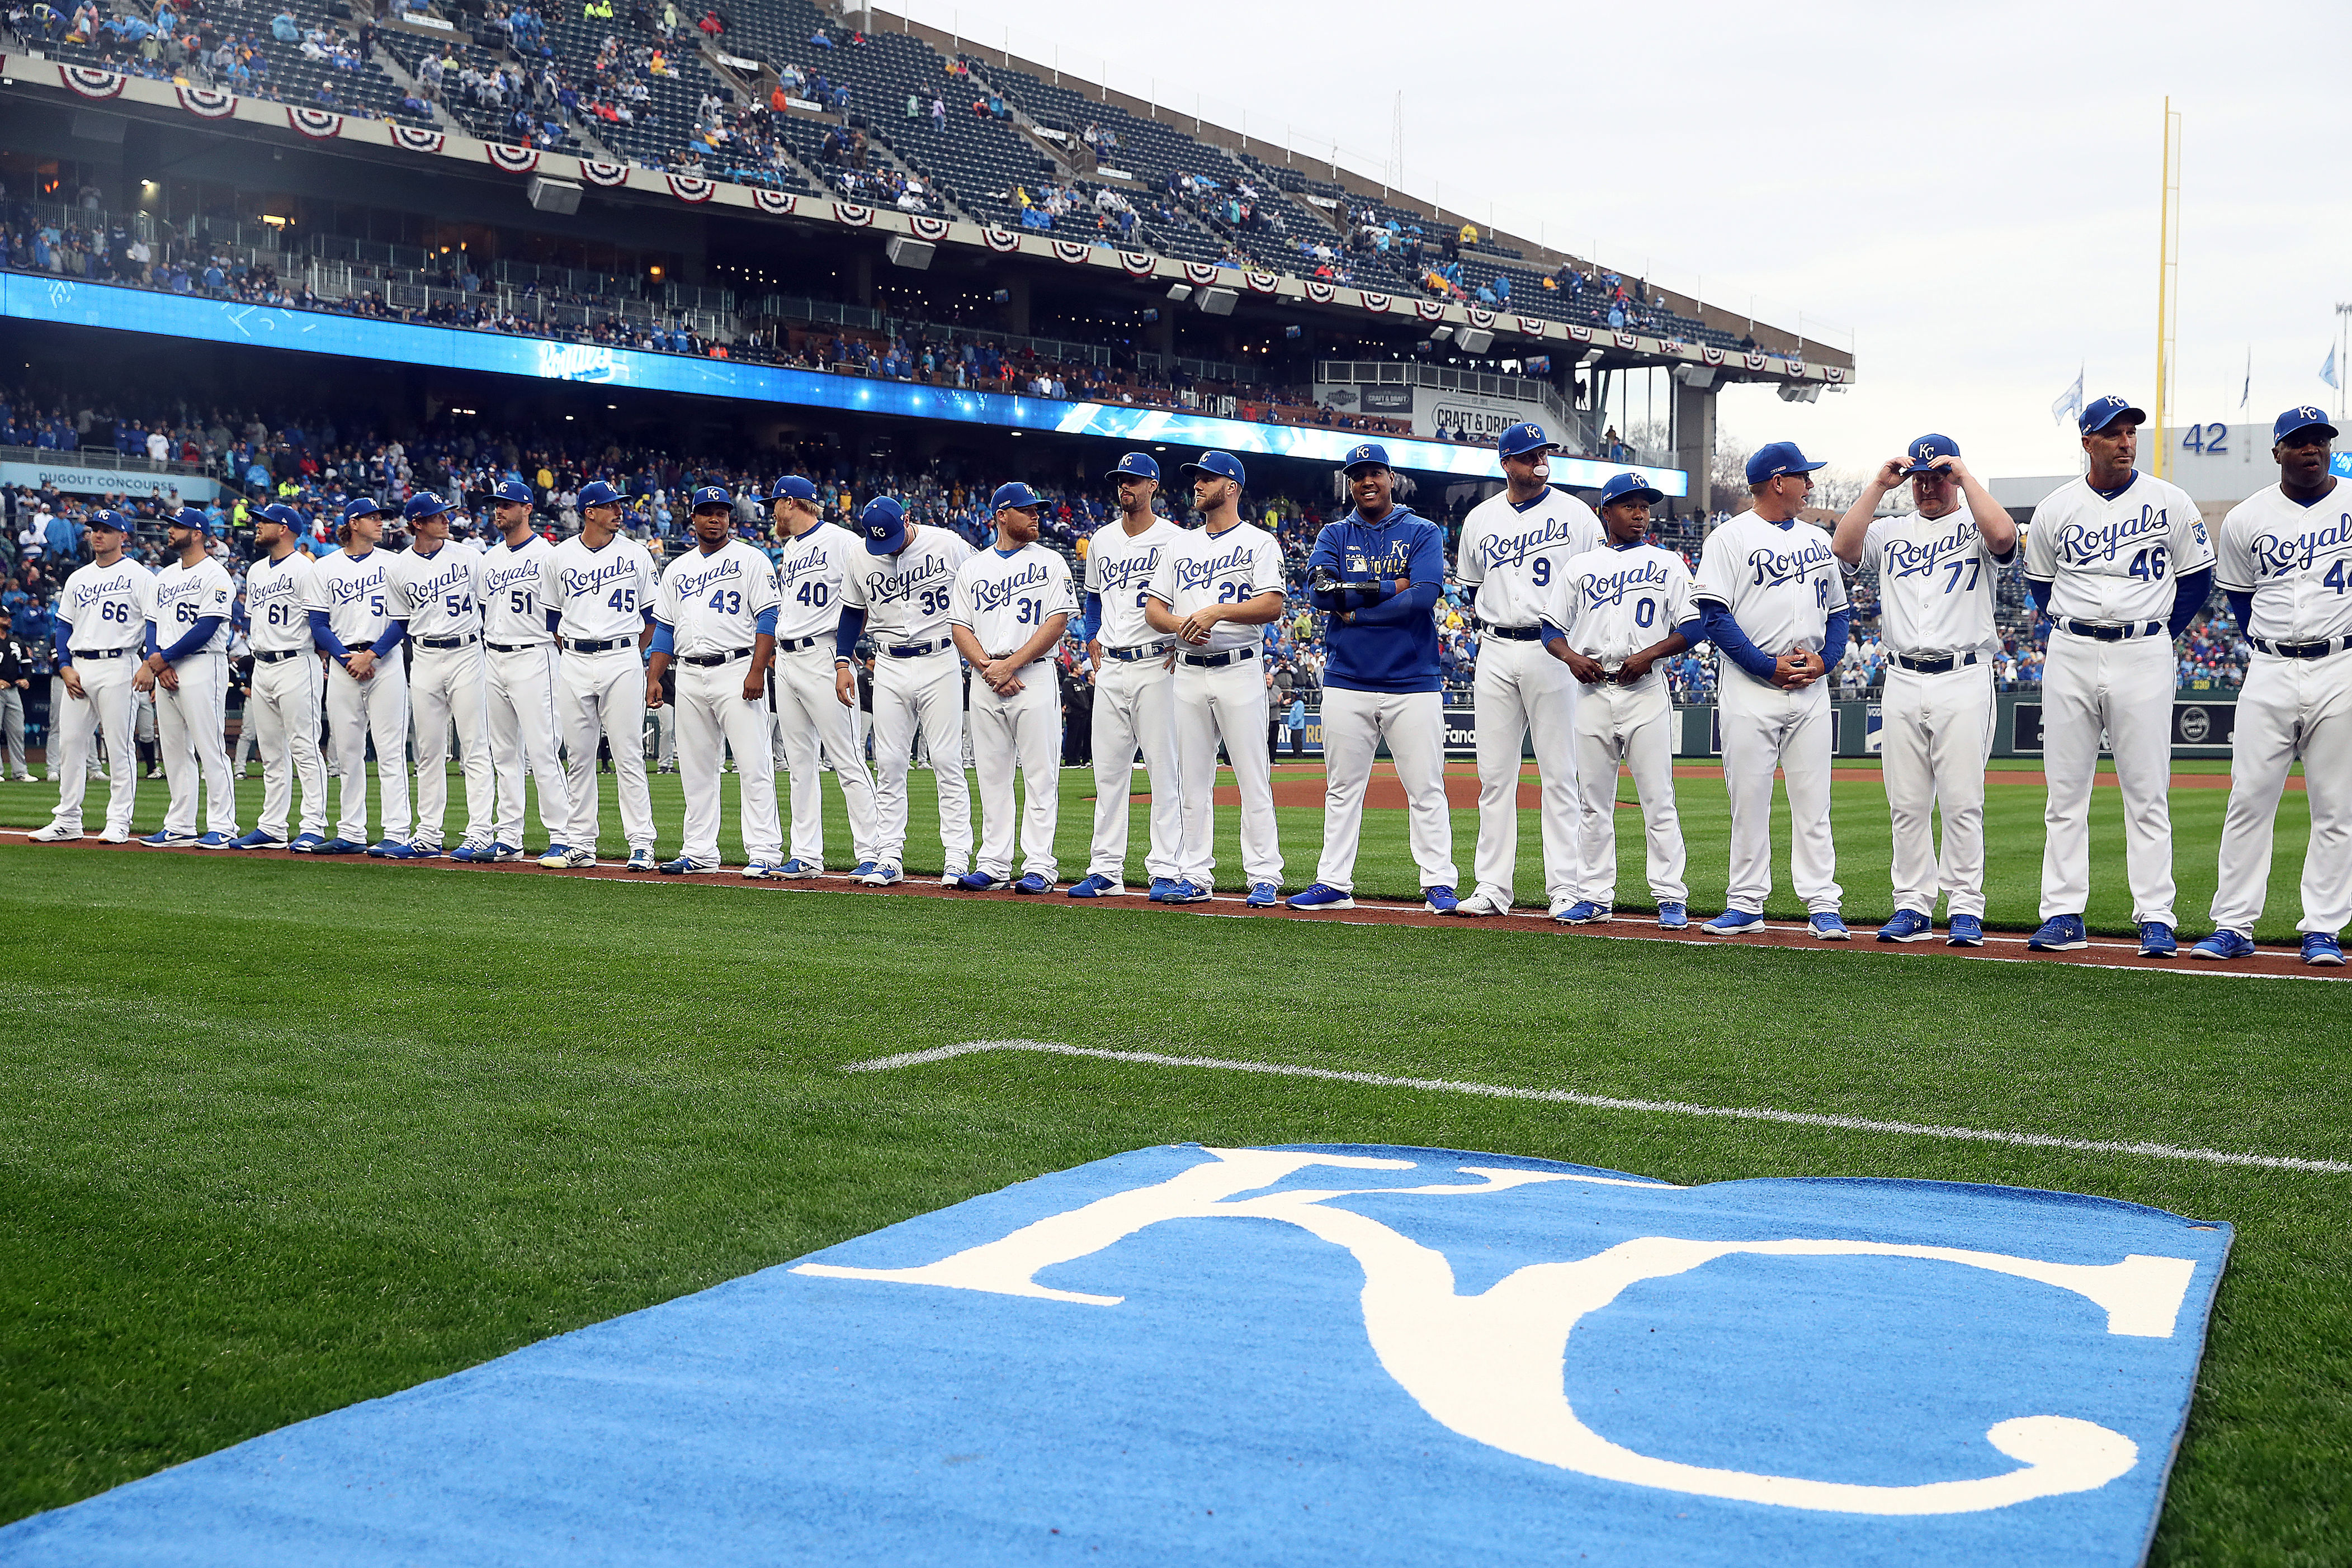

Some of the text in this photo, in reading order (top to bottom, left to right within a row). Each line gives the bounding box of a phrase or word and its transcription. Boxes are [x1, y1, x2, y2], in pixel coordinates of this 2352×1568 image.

[2104, 395, 2125, 407] KC
[2298, 405, 2317, 420] KC
[1438, 409, 1520, 433] CRAFT & DRA
[1524, 424, 1541, 440] KC
[1356, 446, 1369, 459] KC
[1919, 443, 1934, 460] KC
[2183, 423, 2228, 456] 42
[39, 471, 174, 492] DUGOUT CONCOURSE
[707, 488, 720, 500] KC
[1630, 473, 1645, 488] KC
[870, 526, 886, 537] KC
[1480, 518, 1570, 572] Royals
[2059, 504, 2170, 568] Royals
[2193, 527, 2207, 540] KC
[1390, 539, 1410, 560] KC
[1885, 522, 1980, 580] Royals
[485, 559, 540, 596] Royals
[560, 556, 636, 599] Royals
[1174, 546, 1253, 593] Royals
[1532, 557, 1551, 587] 9
[1748, 539, 1834, 591] Royals
[1944, 557, 1981, 594] 77
[2129, 546, 2166, 582] 46
[73, 575, 133, 608] Royals
[157, 575, 202, 608] Royals
[251, 573, 295, 608] Royals
[405, 563, 470, 609] Royals
[673, 558, 742, 604] Royals
[797, 582, 828, 607] 40
[866, 554, 947, 607] Royals
[971, 563, 1049, 615] Royals
[1218, 582, 1253, 604] 26
[1579, 560, 1668, 614] Royals
[1813, 577, 1829, 611] 18
[215, 590, 228, 603] KC
[371, 595, 388, 617] 5
[446, 592, 473, 617] 54
[511, 591, 532, 615] 51
[608, 588, 636, 613] 45
[709, 589, 742, 615] 43
[919, 585, 950, 616] 36
[102, 601, 129, 624] 66
[176, 602, 199, 625] 65
[268, 604, 289, 625] 61
[1017, 597, 1042, 625] 31
[1635, 597, 1656, 629] 0
[788, 1145, 2198, 1518] KC
